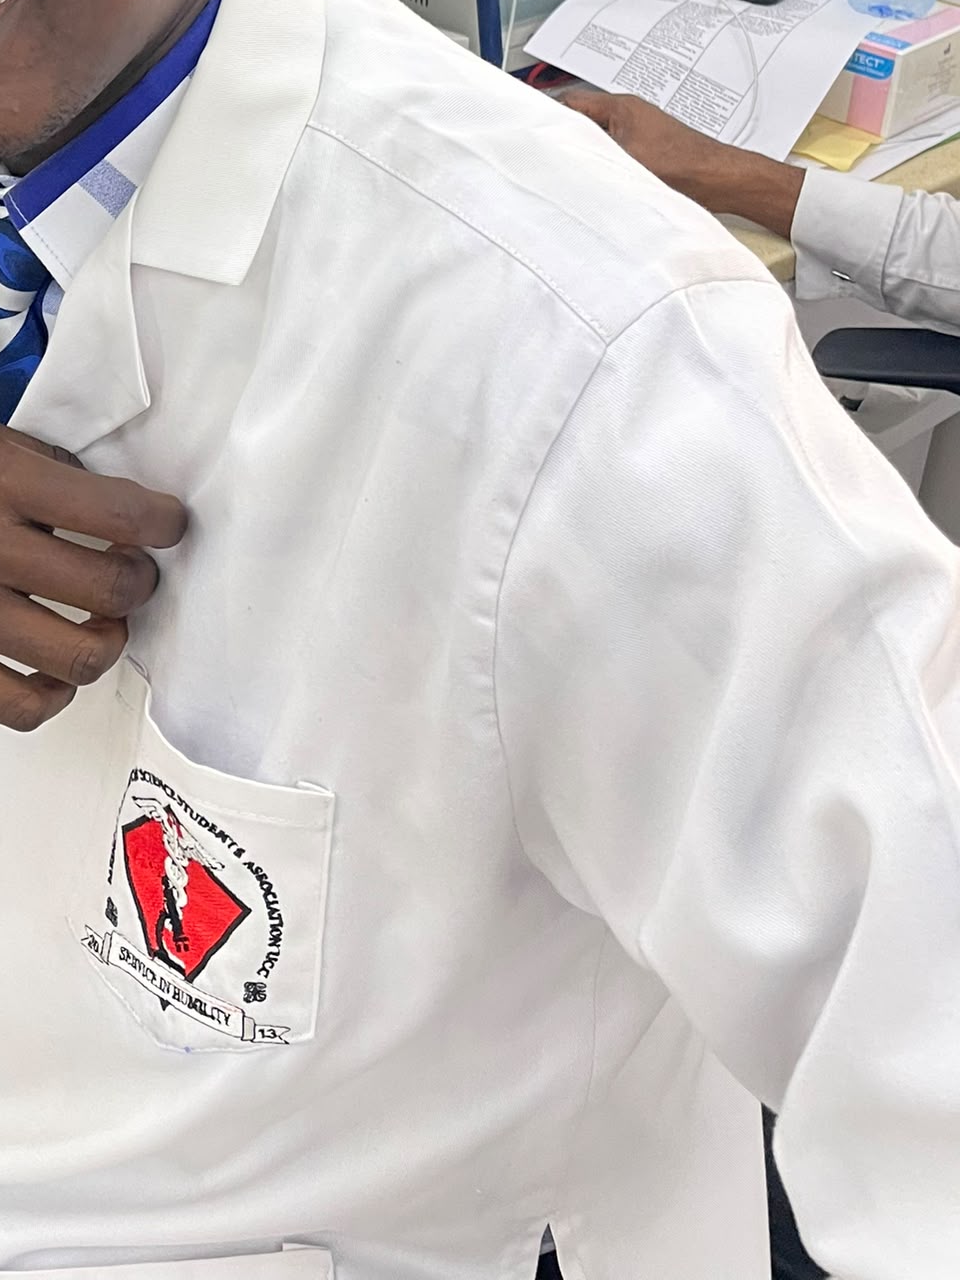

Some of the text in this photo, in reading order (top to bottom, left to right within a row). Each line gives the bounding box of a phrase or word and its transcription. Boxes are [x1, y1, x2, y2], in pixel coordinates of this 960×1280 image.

[854, 51, 881, 68] TECT
[177, 793, 246, 859] STUDENTS
[242, 860, 283, 947] ASSOCIATION
[118, 946, 232, 1027] SERVICE IN HUMILITY
[257, 1028, 277, 1039] 13
